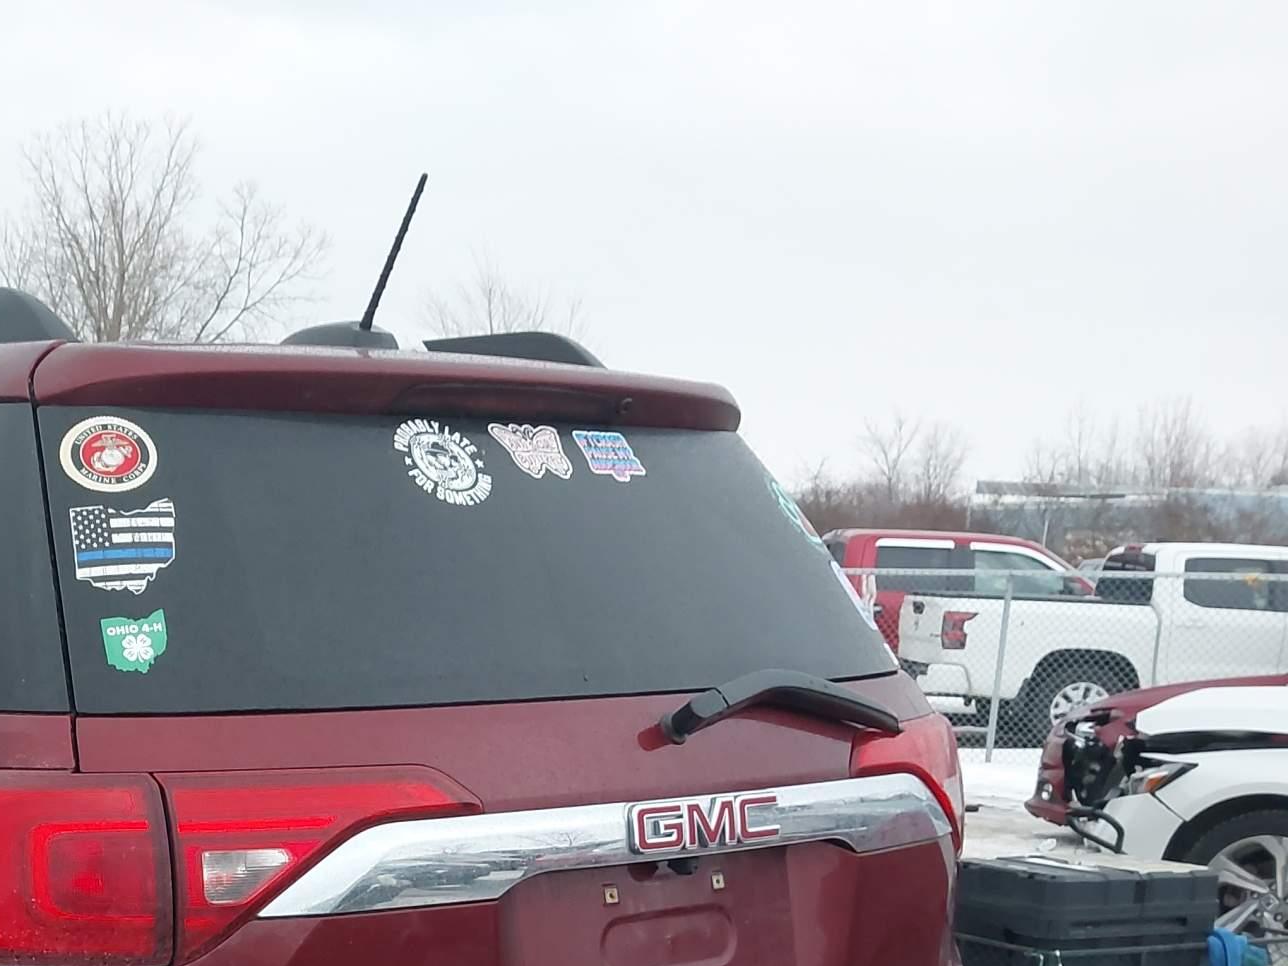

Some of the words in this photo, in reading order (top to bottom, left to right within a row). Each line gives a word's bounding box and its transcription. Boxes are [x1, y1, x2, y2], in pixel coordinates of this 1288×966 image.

[75, 425, 102, 445] UNITED
[108, 425, 138, 440] STATES
[394, 419, 439, 452] PROBABLY
[444, 426, 477, 455] LATE
[80, 467, 117, 485] MARINE
[122, 463, 147, 482] CORPS
[408, 468, 434, 494] FOR
[436, 473, 492, 506] SOMETHING
[106, 624, 139, 636] OHIO
[141, 622, 163, 633] 4-H
[631, 793, 781, 853] GMC
